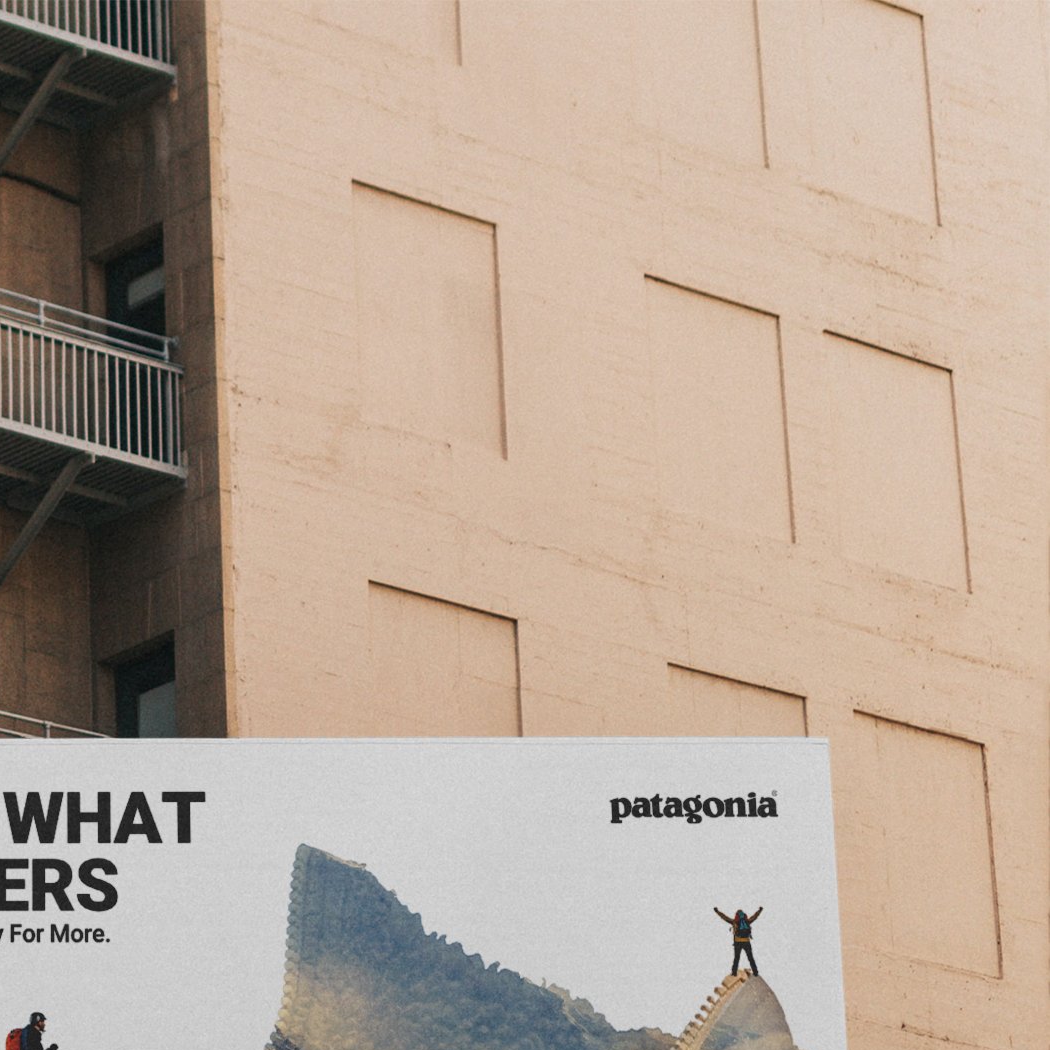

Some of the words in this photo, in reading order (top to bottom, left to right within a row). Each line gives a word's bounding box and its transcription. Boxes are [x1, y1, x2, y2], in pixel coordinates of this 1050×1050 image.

[2, 791, 206, 844] WHAT
[609, 791, 779, 824] patagonia
[10, 924, 45, 944] For
[50, 924, 111, 944] More.
